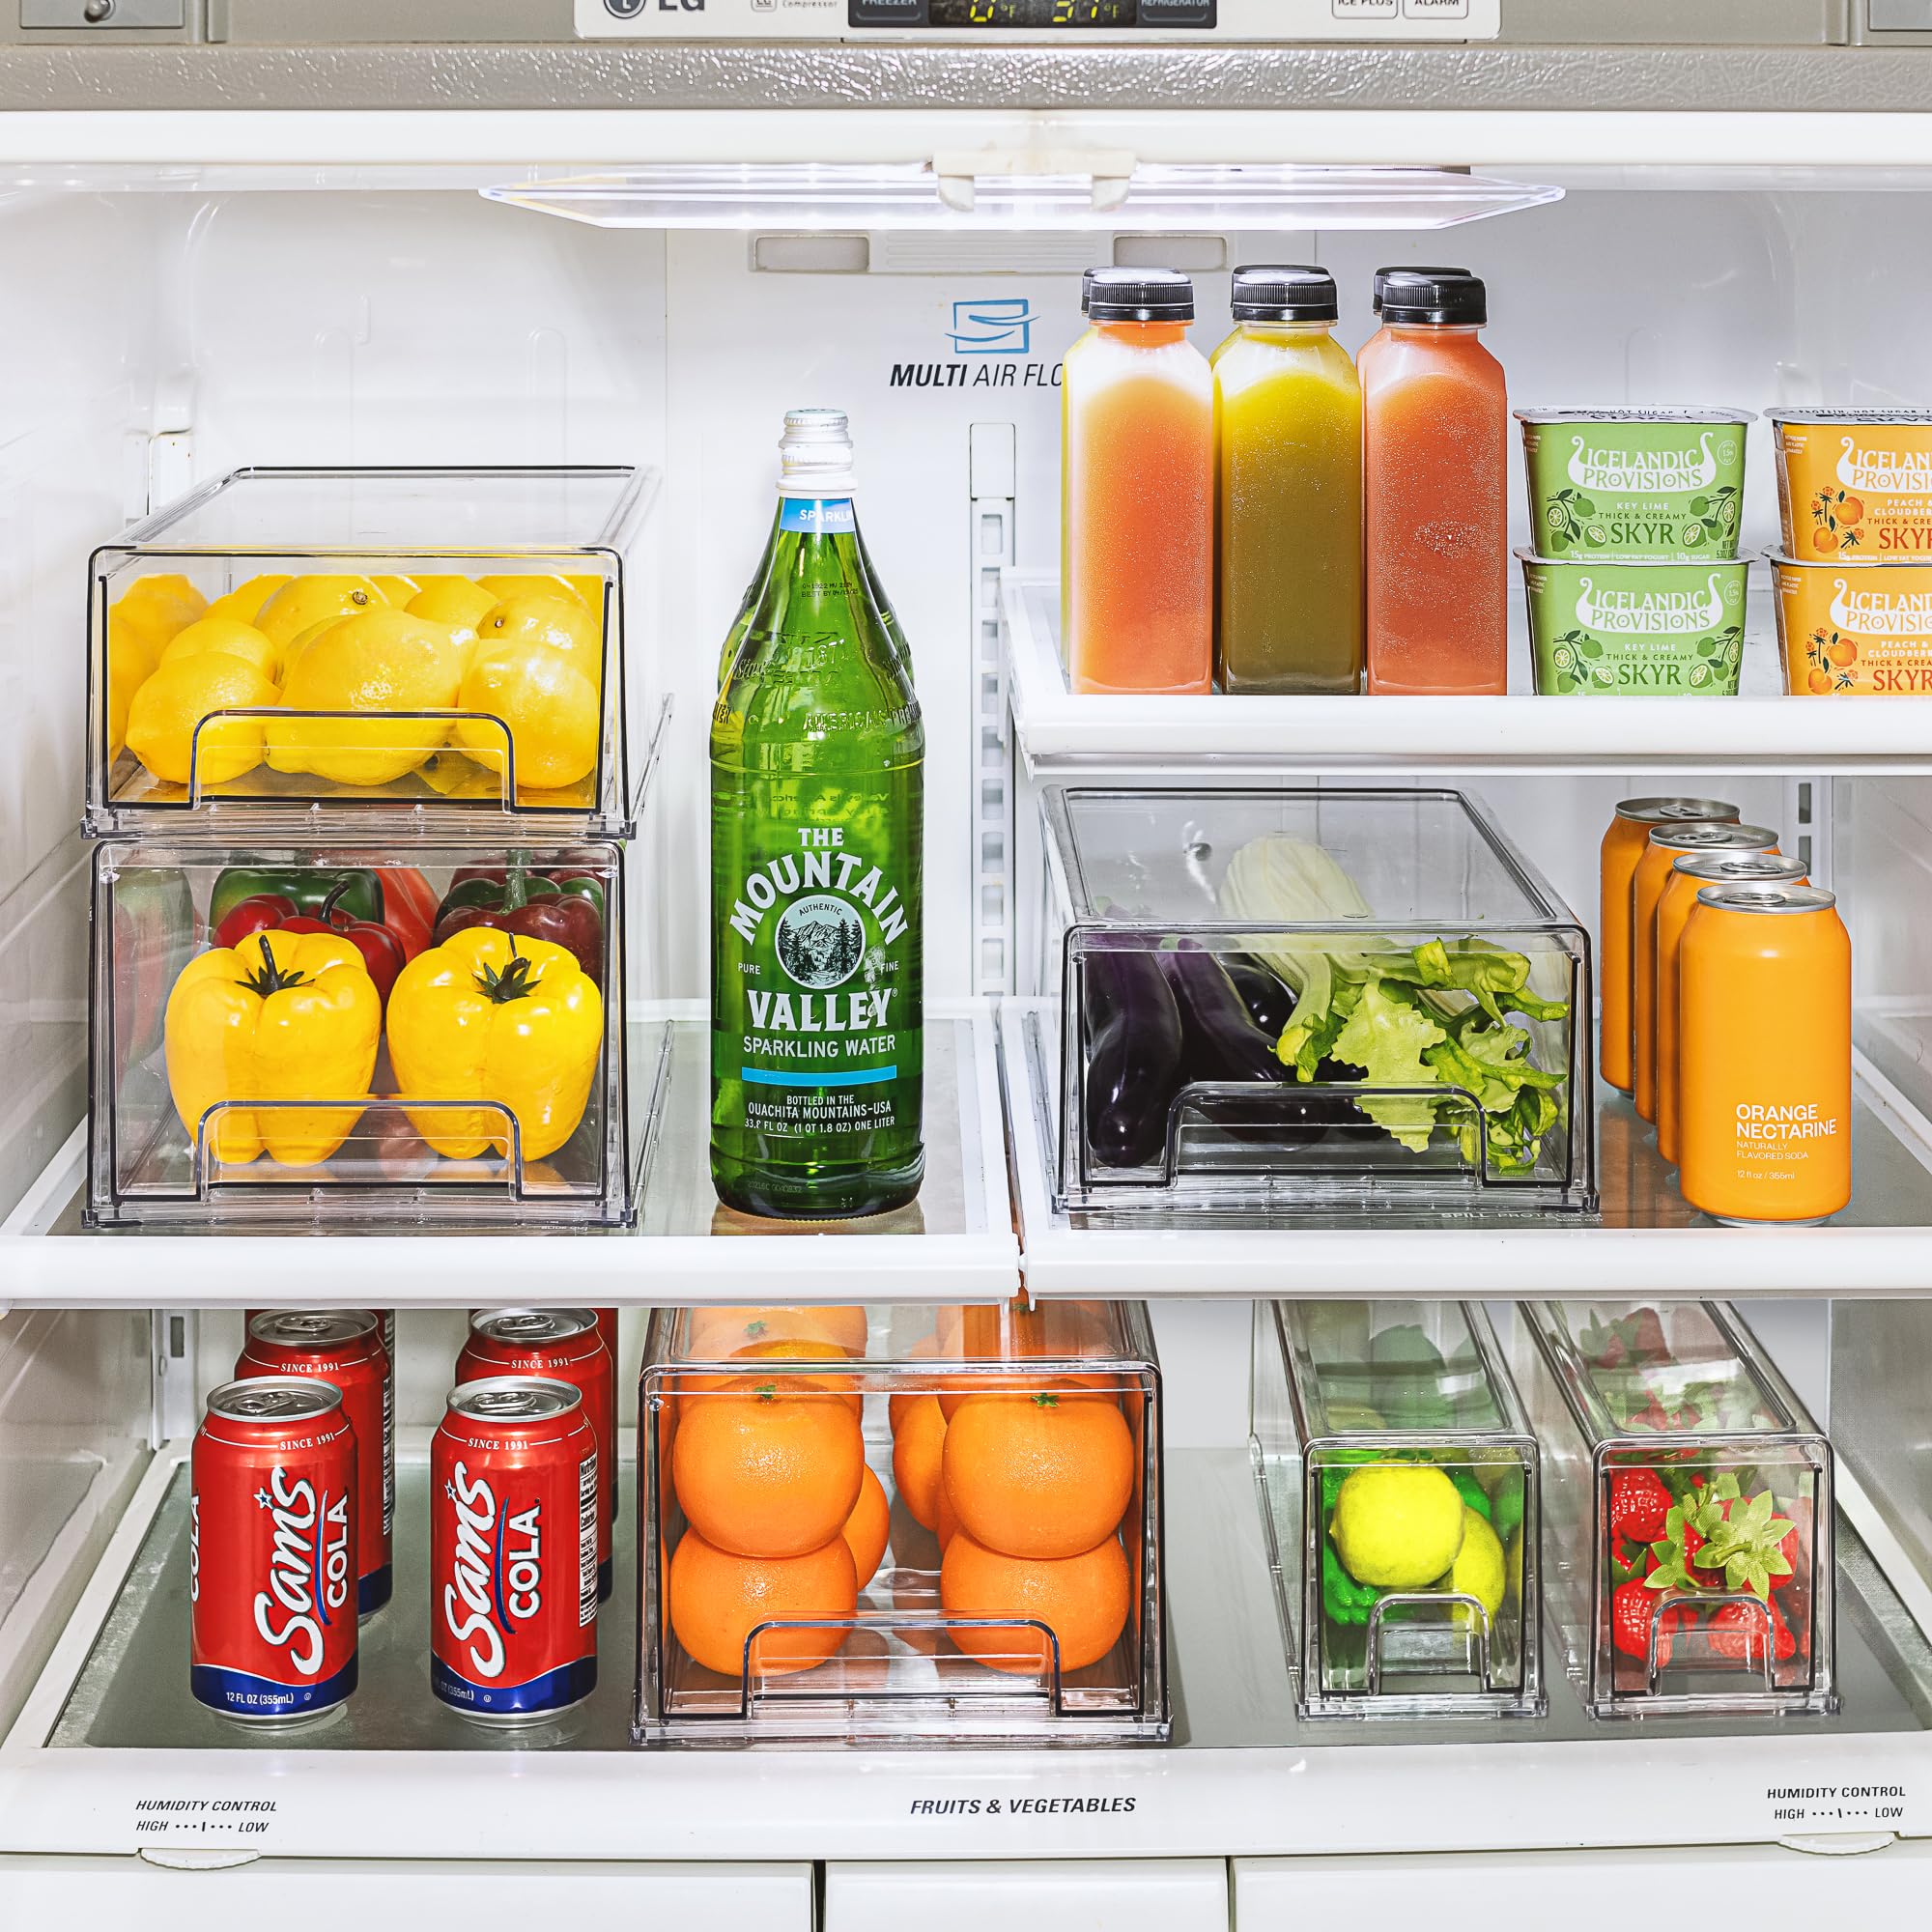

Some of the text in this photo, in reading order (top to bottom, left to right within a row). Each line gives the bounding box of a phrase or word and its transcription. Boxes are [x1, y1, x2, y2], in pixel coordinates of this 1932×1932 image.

[890, 364, 967, 386] MULTI
[972, 364, 1017, 386] AIR
[1586, 447, 1699, 470] ICELANDIC
[1583, 469, 1703, 491] PROVISIONS
[1610, 523, 1675, 545] SKYR
[1595, 590, 1707, 611] ICELANDIC
[1592, 610, 1710, 631] PROVISIONS
[1625, 642, 1676, 651] KEY LIME
[1618, 664, 1681, 685] SKYR
[798, 828, 844, 847] THE
[729, 850, 909, 946] MOUNTAIN
[799, 903, 842, 916] AUTHENTIC
[738, 962, 761, 975] PURE
[880, 960, 899, 974] FINE
[743, 1034, 895, 1058] SPARKLING WATER
[786, 1094, 855, 1105] BOTTLED IN THE
[748, 1101, 799, 1119] OUACHITA
[1736, 1103, 1818, 1121] ORANGE
[764, 1121, 774, 1131] FL
[777, 1122, 788, 1132] OZ
[794, 1122, 802, 1133] (1
[819, 1122, 833, 1133] 1.8
[836, 1122, 852, 1133] OZ)
[855, 1120, 872, 1131] ONE
[873, 1116, 895, 1129] LITER
[1736, 1118, 1837, 1140] NECTARINE
[1736, 1141, 1787, 1150] NATURALLY
[1736, 1151, 1783, 1159] FLAVORED
[1737, 1170, 1745, 1179] 12
[1747, 1170, 1752, 1179] fl
[280, 1361, 339, 1373] SINCE 1991
[511, 1357, 569, 1370] SINCE 1991
[279, 1433, 336, 1451] SINCE 1991
[468, 1437, 528, 1450] SINCE 1991
[190, 1494, 200, 1603] COLA
[327, 1494, 349, 1608] COLA
[508, 1507, 541, 1620] COLA
[226, 1692, 294, 1705] 12 FL OZ (355mL)
[1767, 1786, 1906, 1799] HUMIDITY CONTROL
[135, 1800, 277, 1811] HUMIDITY CONTROL
[911, 1797, 1136, 1814] FRUITS & VEGETABLES
[1775, 1807, 1903, 1819] HIGH LOW
[136, 1820, 270, 1833] HIGH LOW
